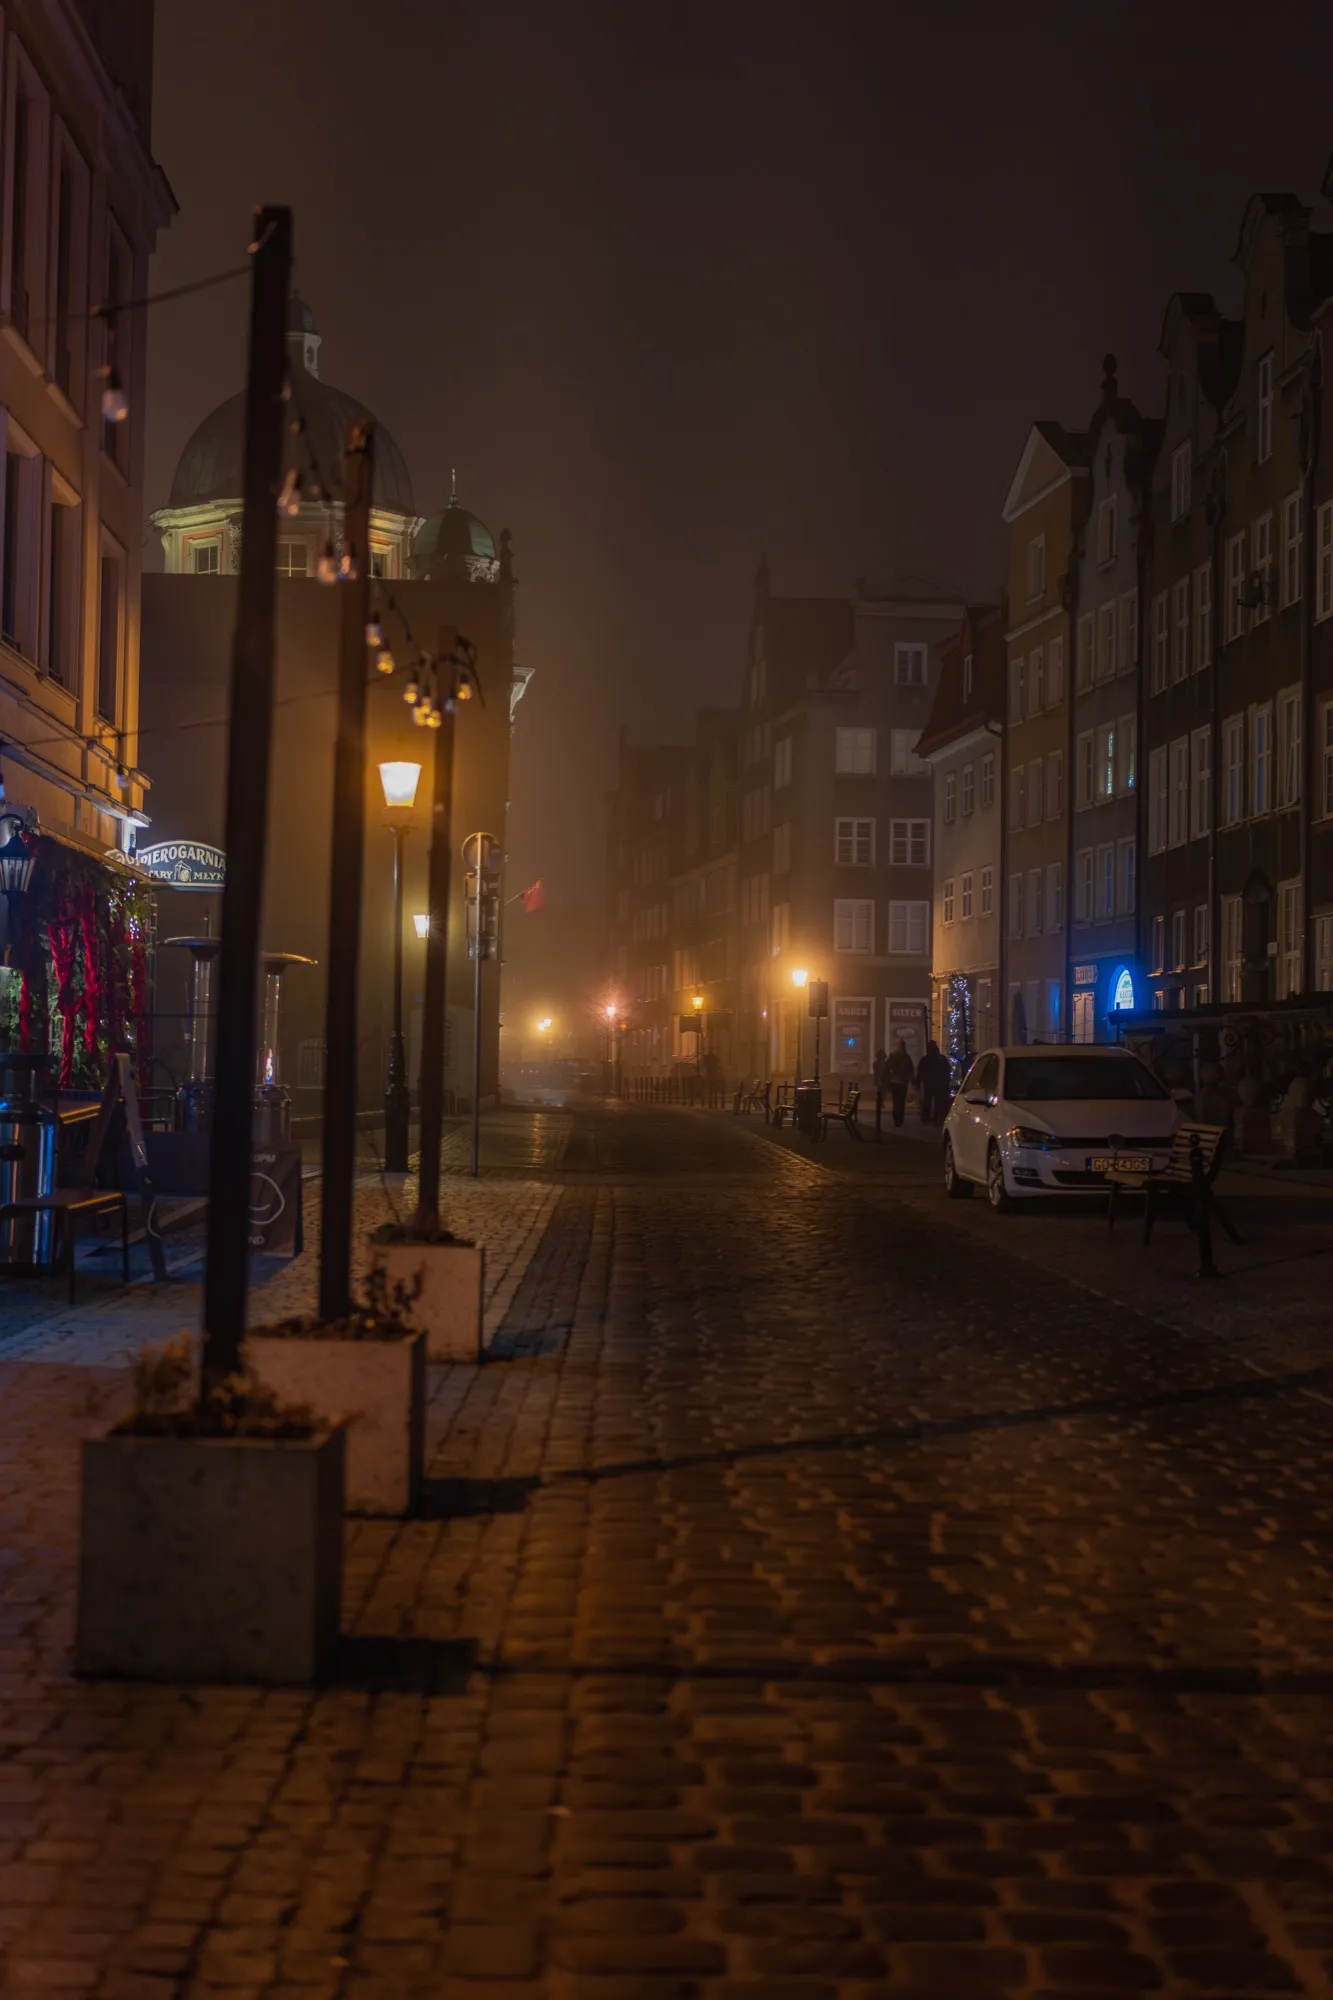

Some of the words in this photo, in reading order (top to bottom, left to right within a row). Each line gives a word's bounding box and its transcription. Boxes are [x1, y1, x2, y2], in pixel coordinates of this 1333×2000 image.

[140, 845, 226, 871] PIEROGARNIA
[144, 870, 174, 879] TARY
[193, 871, 224, 880] MŁYN
[892, 1008, 922, 1017] SILVER
[1094, 1158, 1109, 1171] GD
